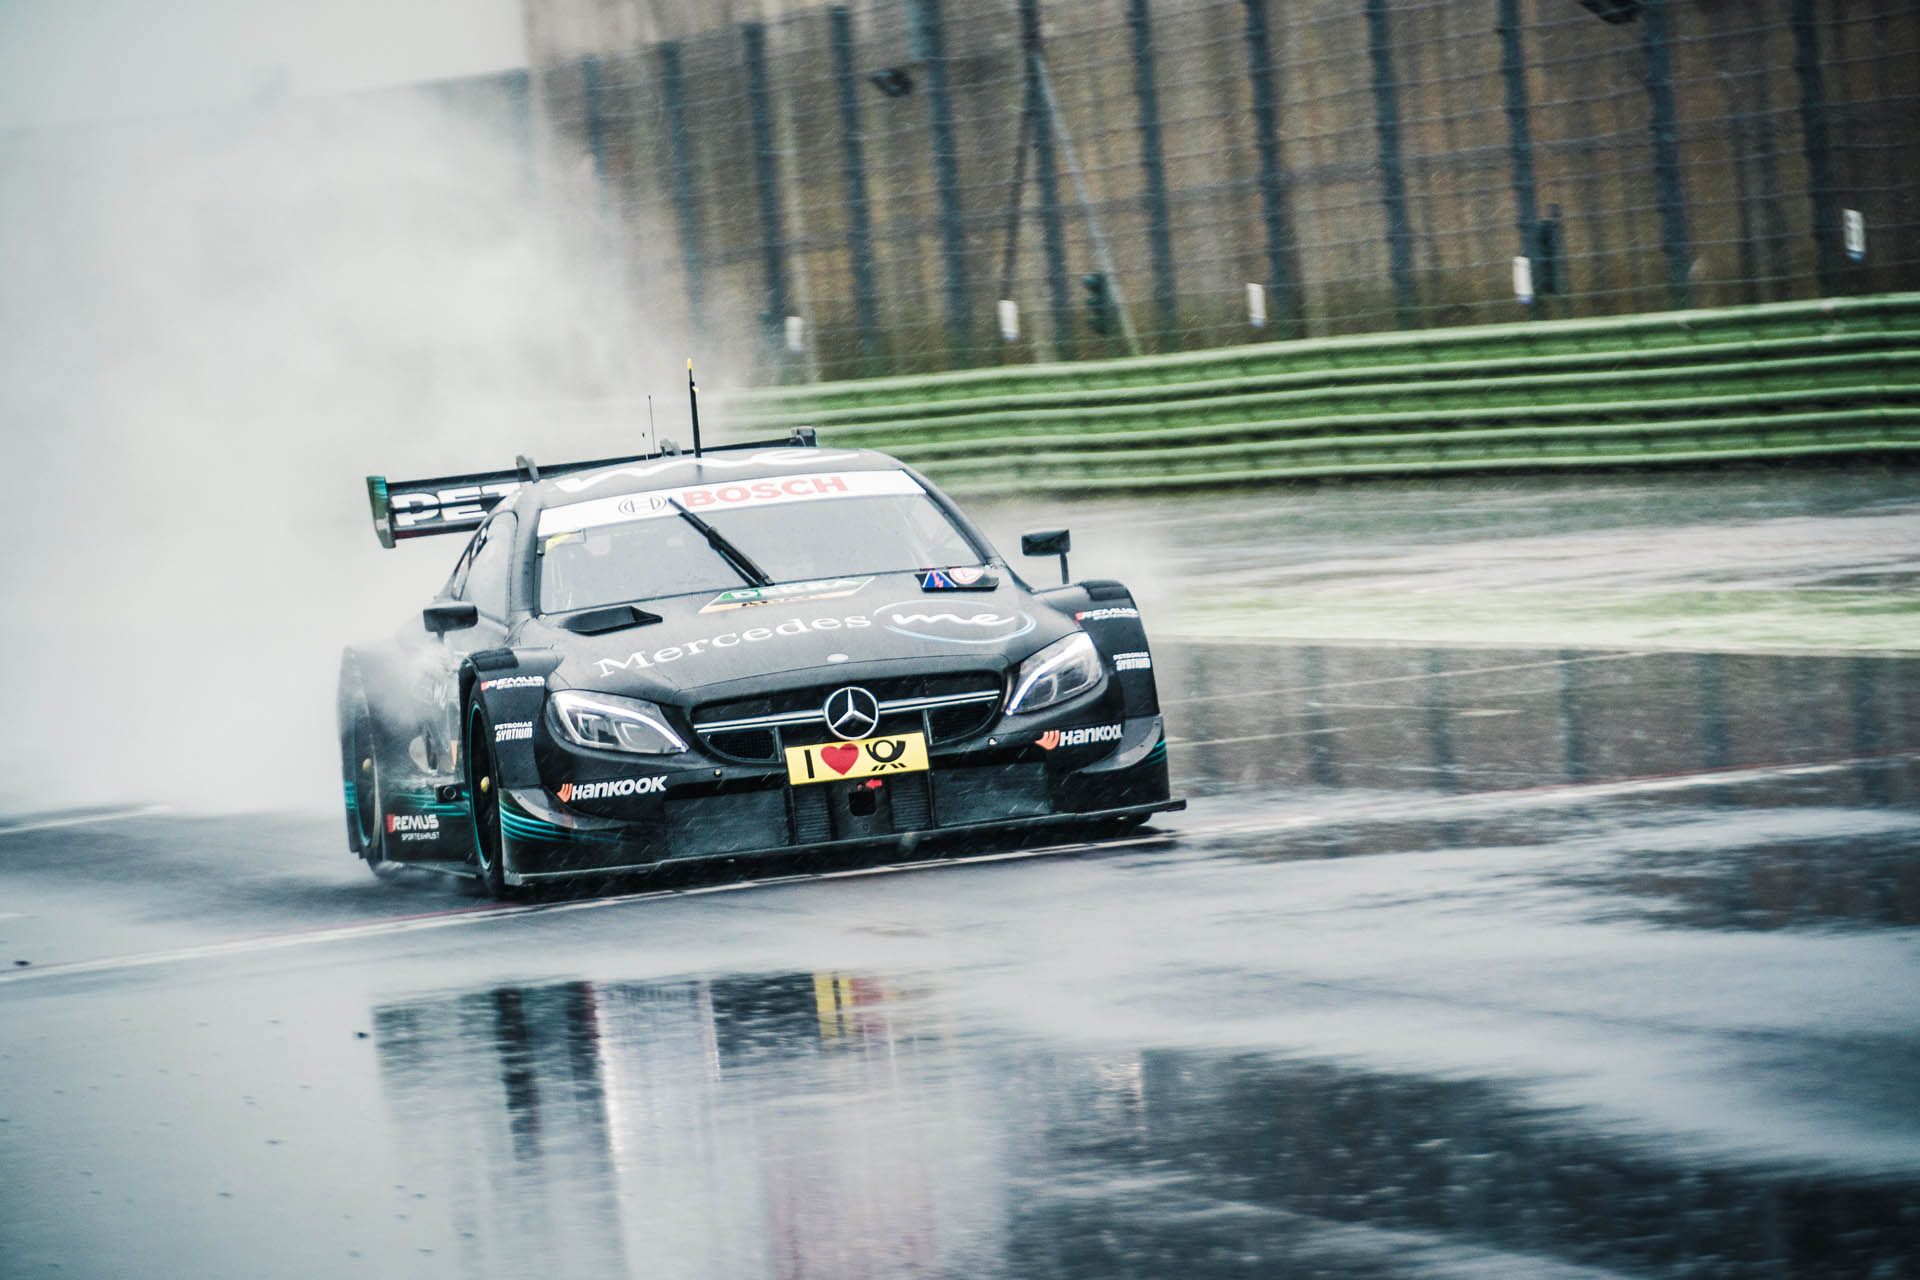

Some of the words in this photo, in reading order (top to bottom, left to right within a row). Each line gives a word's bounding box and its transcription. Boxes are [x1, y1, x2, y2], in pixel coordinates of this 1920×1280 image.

[682, 476, 848, 508] BOSCH
[591, 615, 872, 678] Mercedes
[892, 613, 1015, 627] me
[804, 749, 815, 779] I
[392, 814, 439, 831] REMUS
